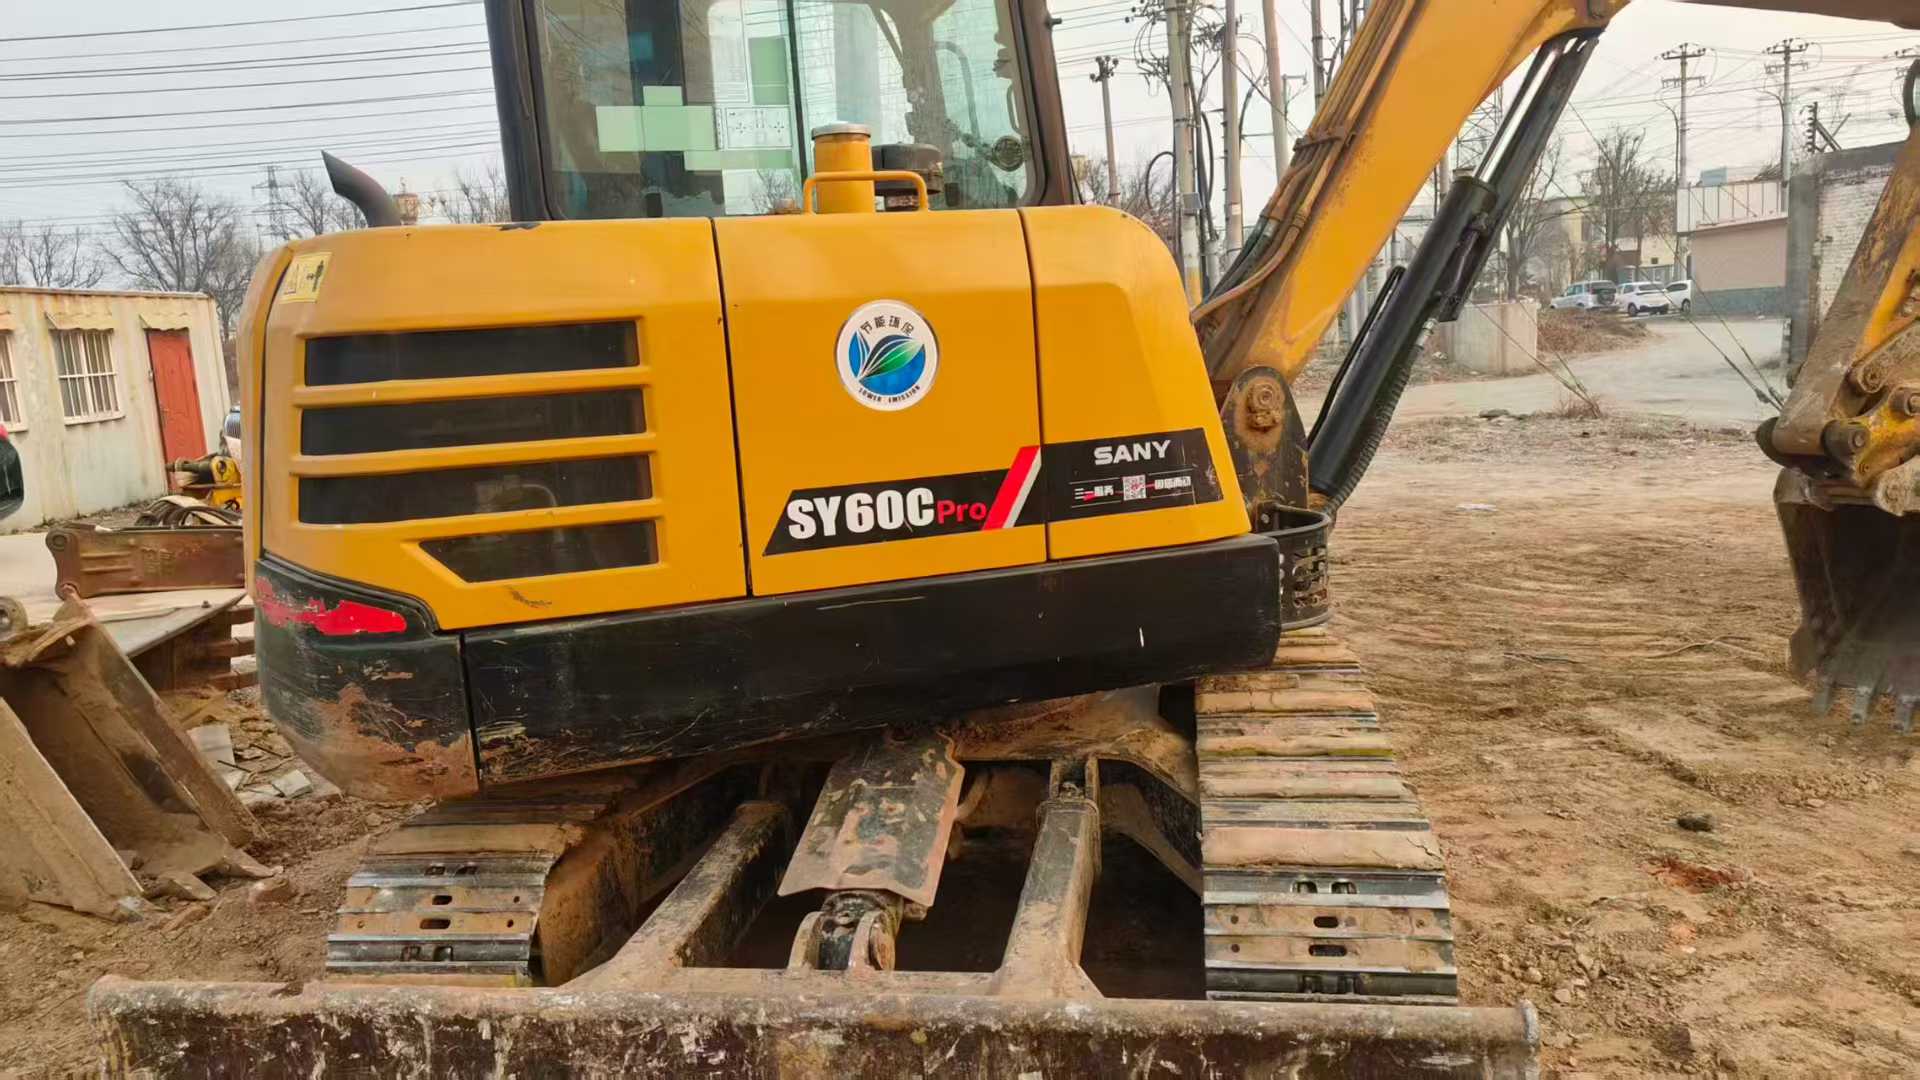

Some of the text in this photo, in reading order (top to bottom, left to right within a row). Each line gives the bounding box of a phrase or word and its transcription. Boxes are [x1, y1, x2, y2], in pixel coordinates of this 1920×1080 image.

[1093, 439, 1172, 466] SANY
[786, 486, 988, 540] SY60C Pro
